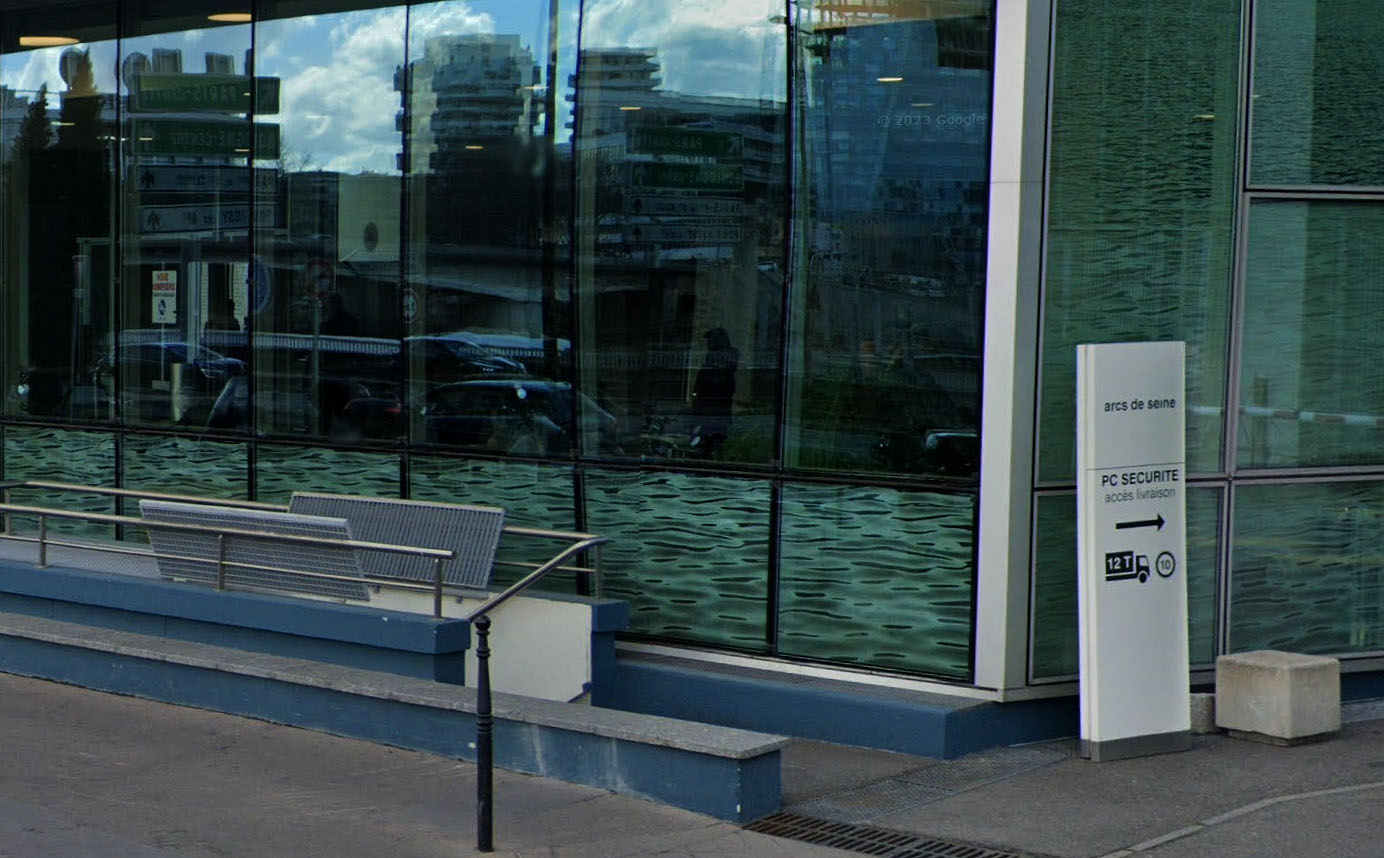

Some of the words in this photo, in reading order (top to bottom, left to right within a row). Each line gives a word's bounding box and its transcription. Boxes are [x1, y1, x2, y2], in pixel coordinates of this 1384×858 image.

[1104, 401, 1128, 412] arcs
[1130, 397, 1144, 410] de
[1147, 398, 1176, 410] seine
[1101, 473, 1118, 487] PC
[1121, 469, 1179, 486] SECURITE
[1136, 486, 1176, 501] livraison
[1107, 557, 1121, 570] 12
